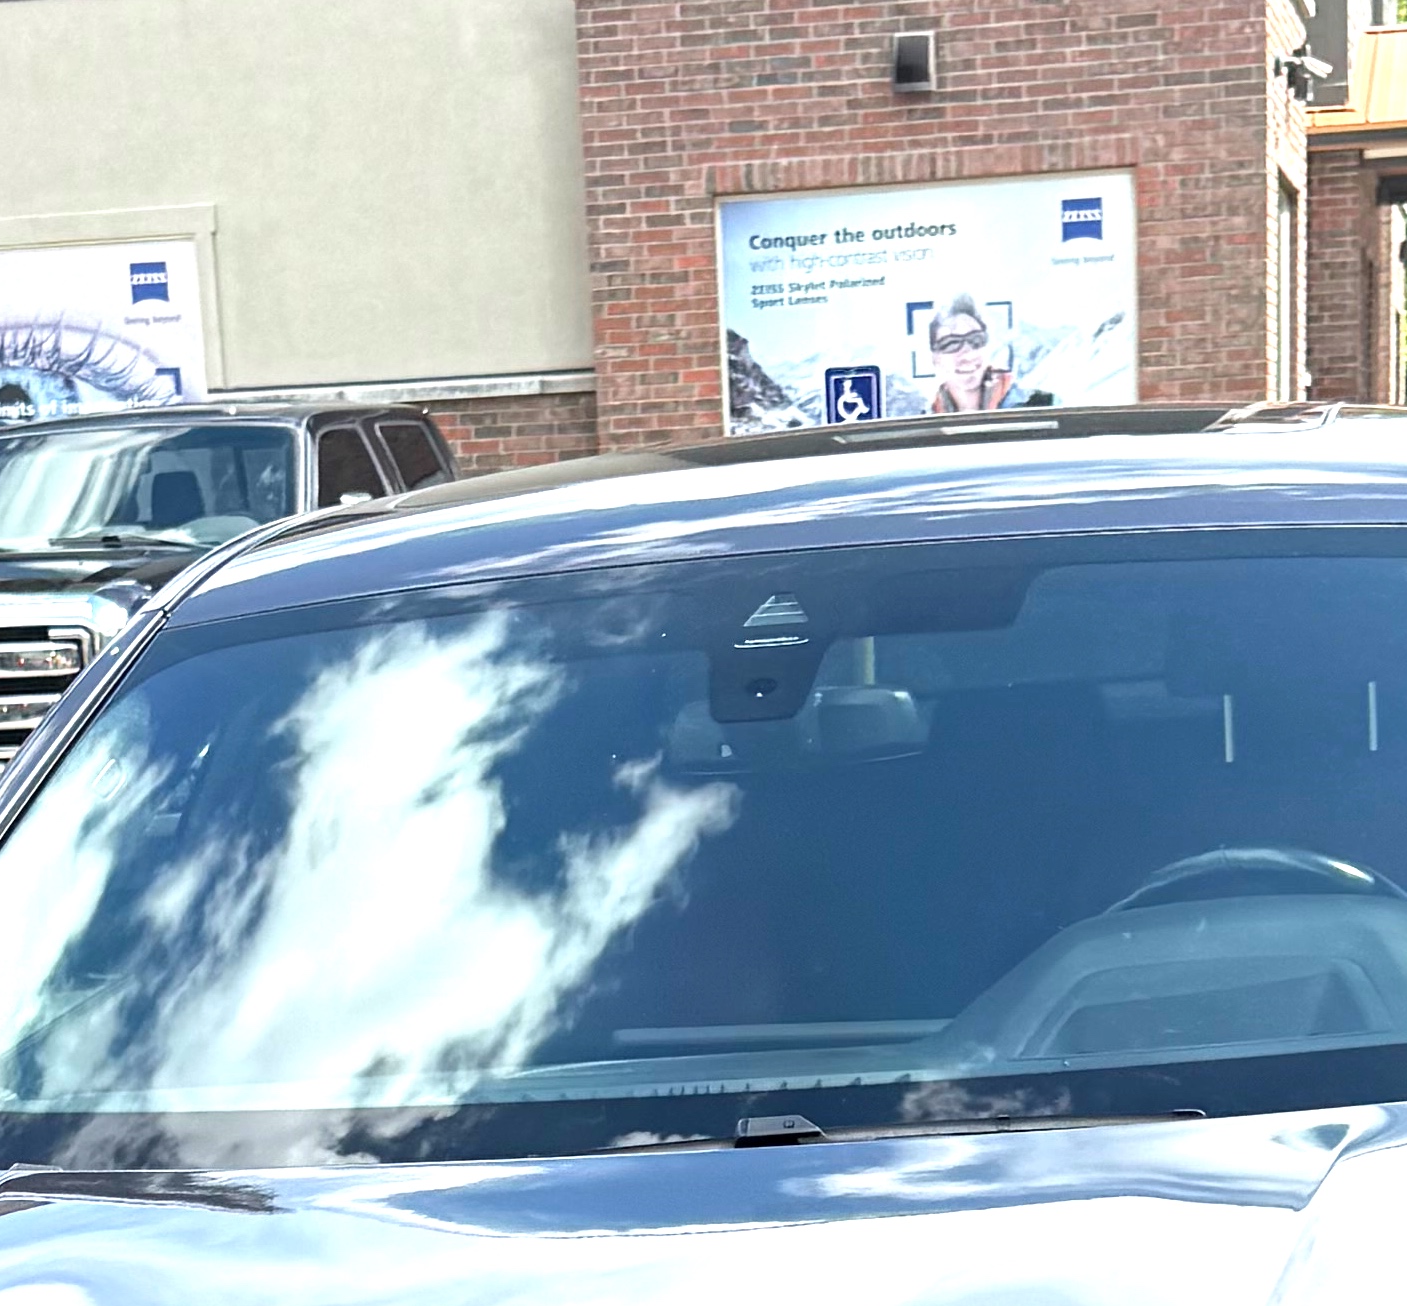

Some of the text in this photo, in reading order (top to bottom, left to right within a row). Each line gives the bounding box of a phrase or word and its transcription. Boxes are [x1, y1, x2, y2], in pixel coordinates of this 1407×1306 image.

[749, 222, 957, 251] Conquer the outdoors
